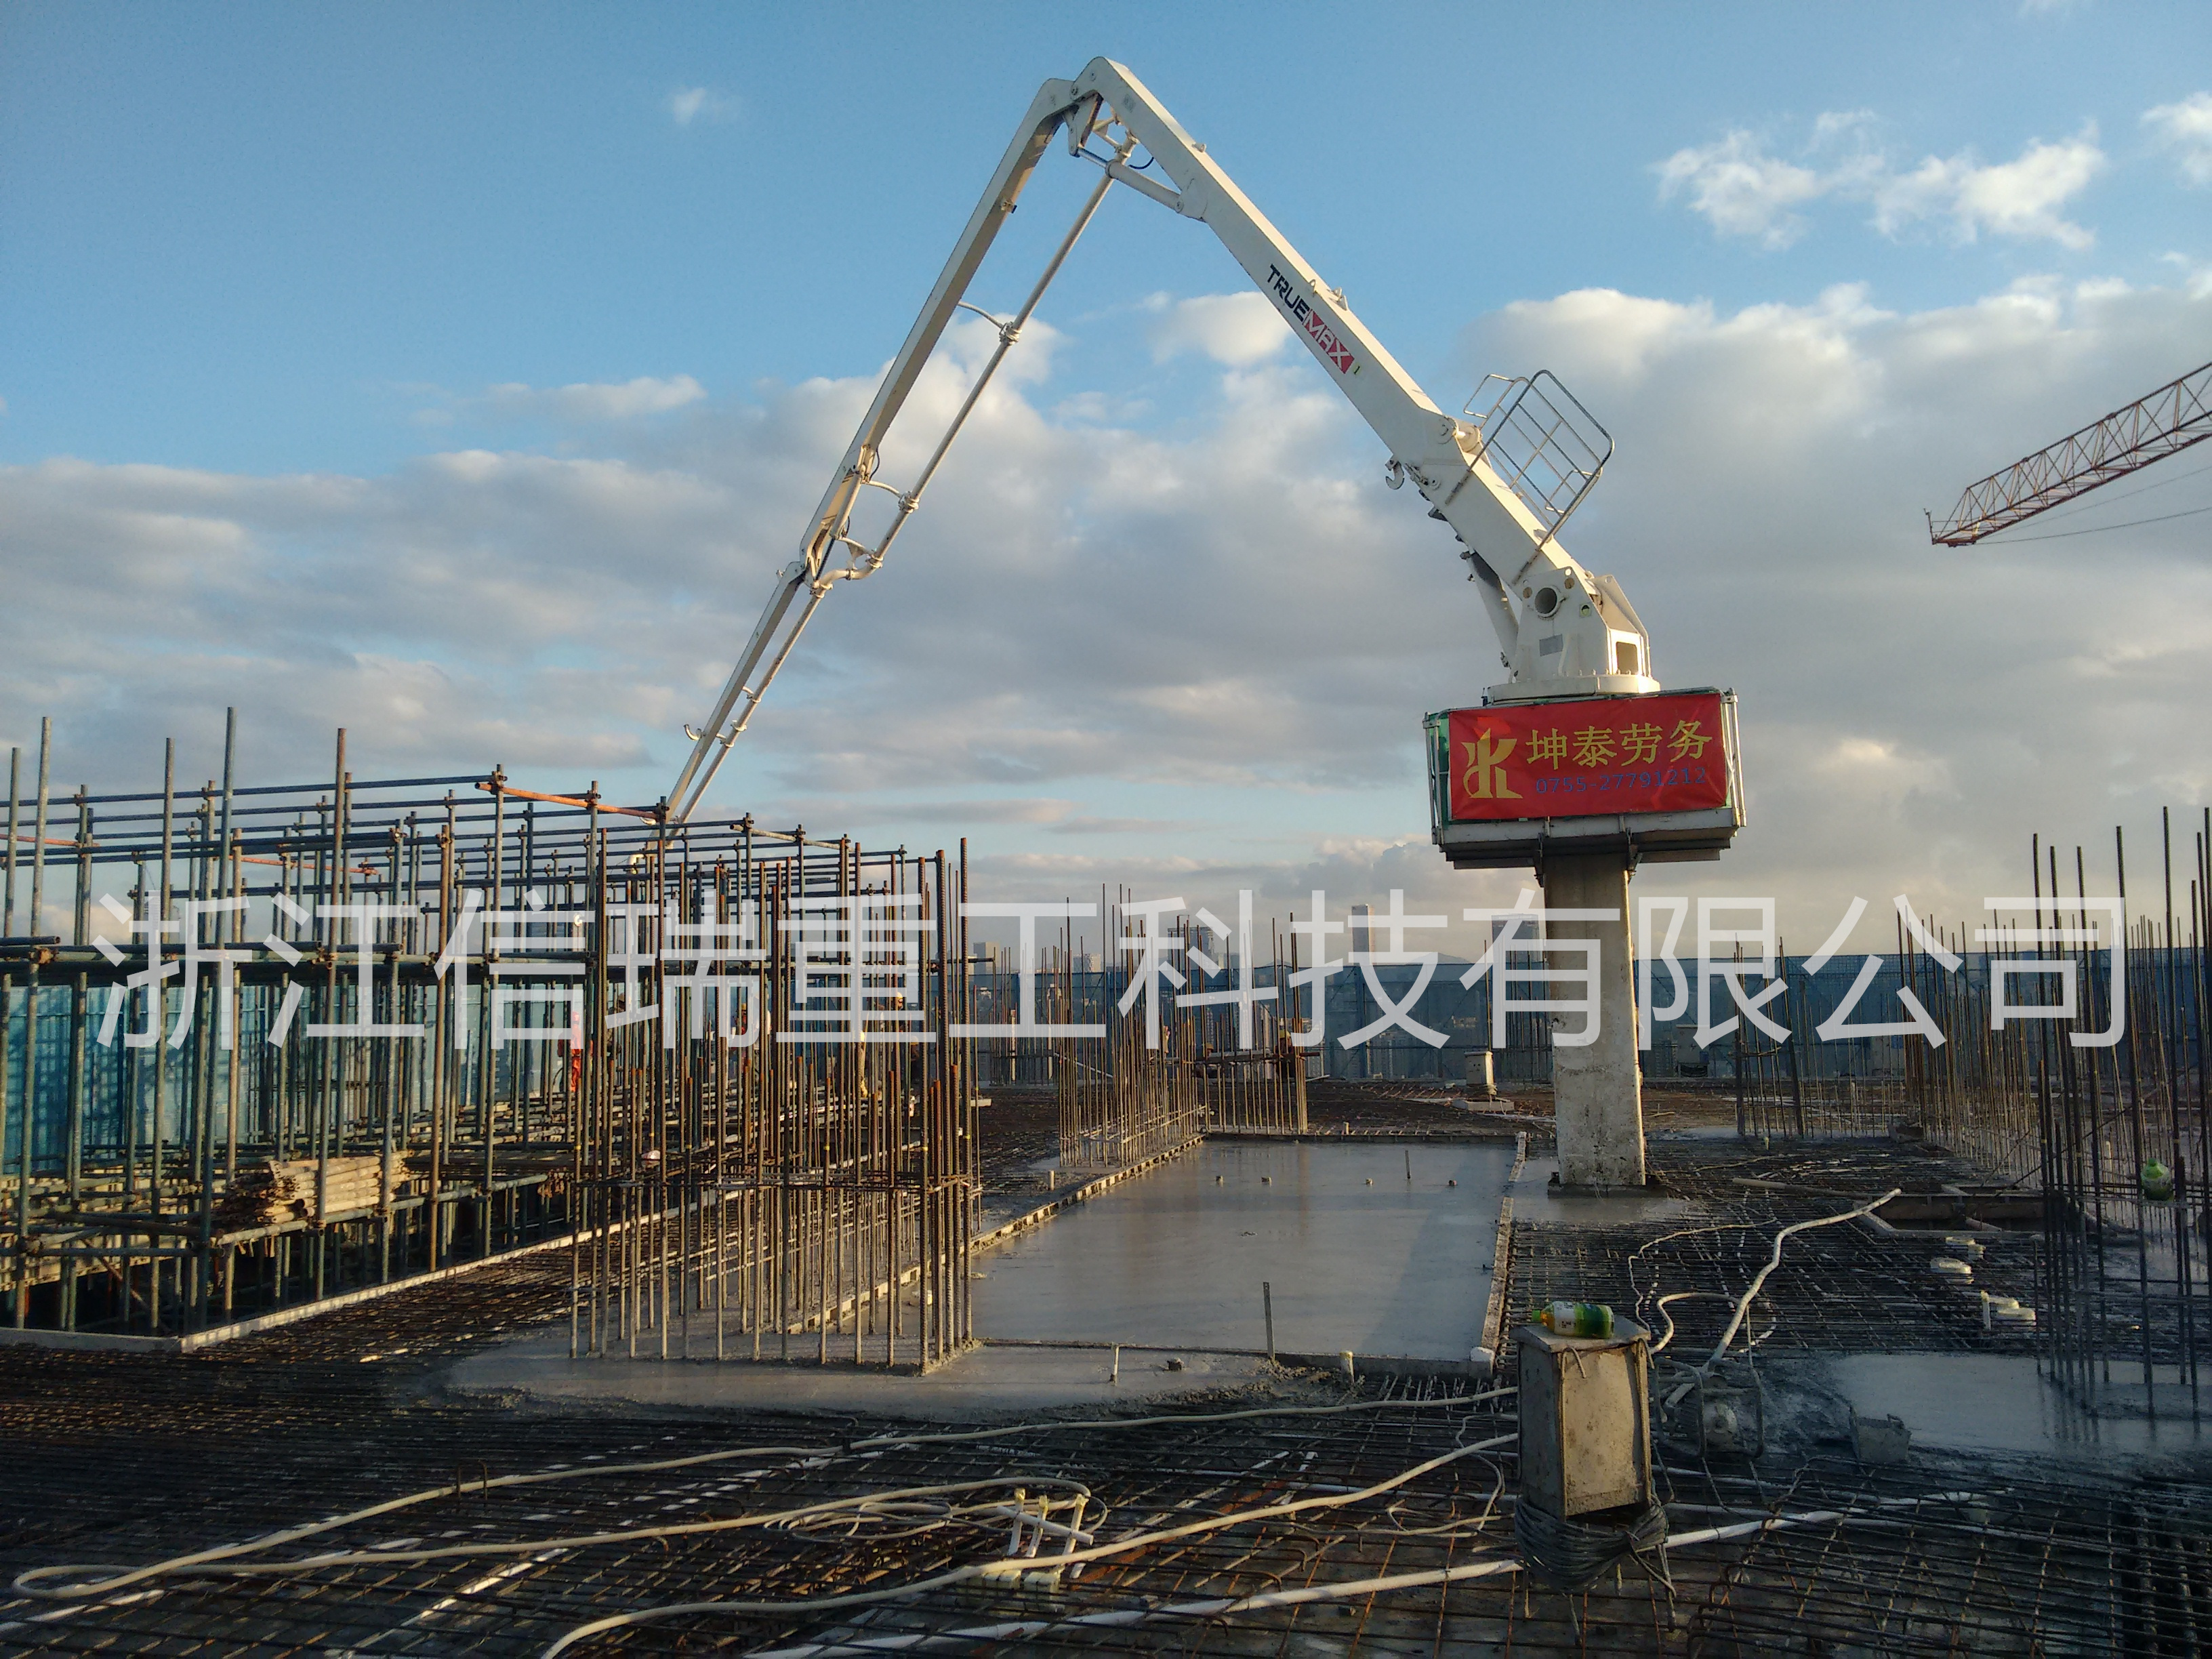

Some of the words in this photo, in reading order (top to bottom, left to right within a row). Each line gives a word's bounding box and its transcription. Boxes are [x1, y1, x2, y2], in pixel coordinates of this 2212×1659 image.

[1267, 264, 1355, 374] TRUEMAX
[1525, 720, 1713, 770] 坤泰劳务
[1536, 766, 1706, 794] 0755-27791212
